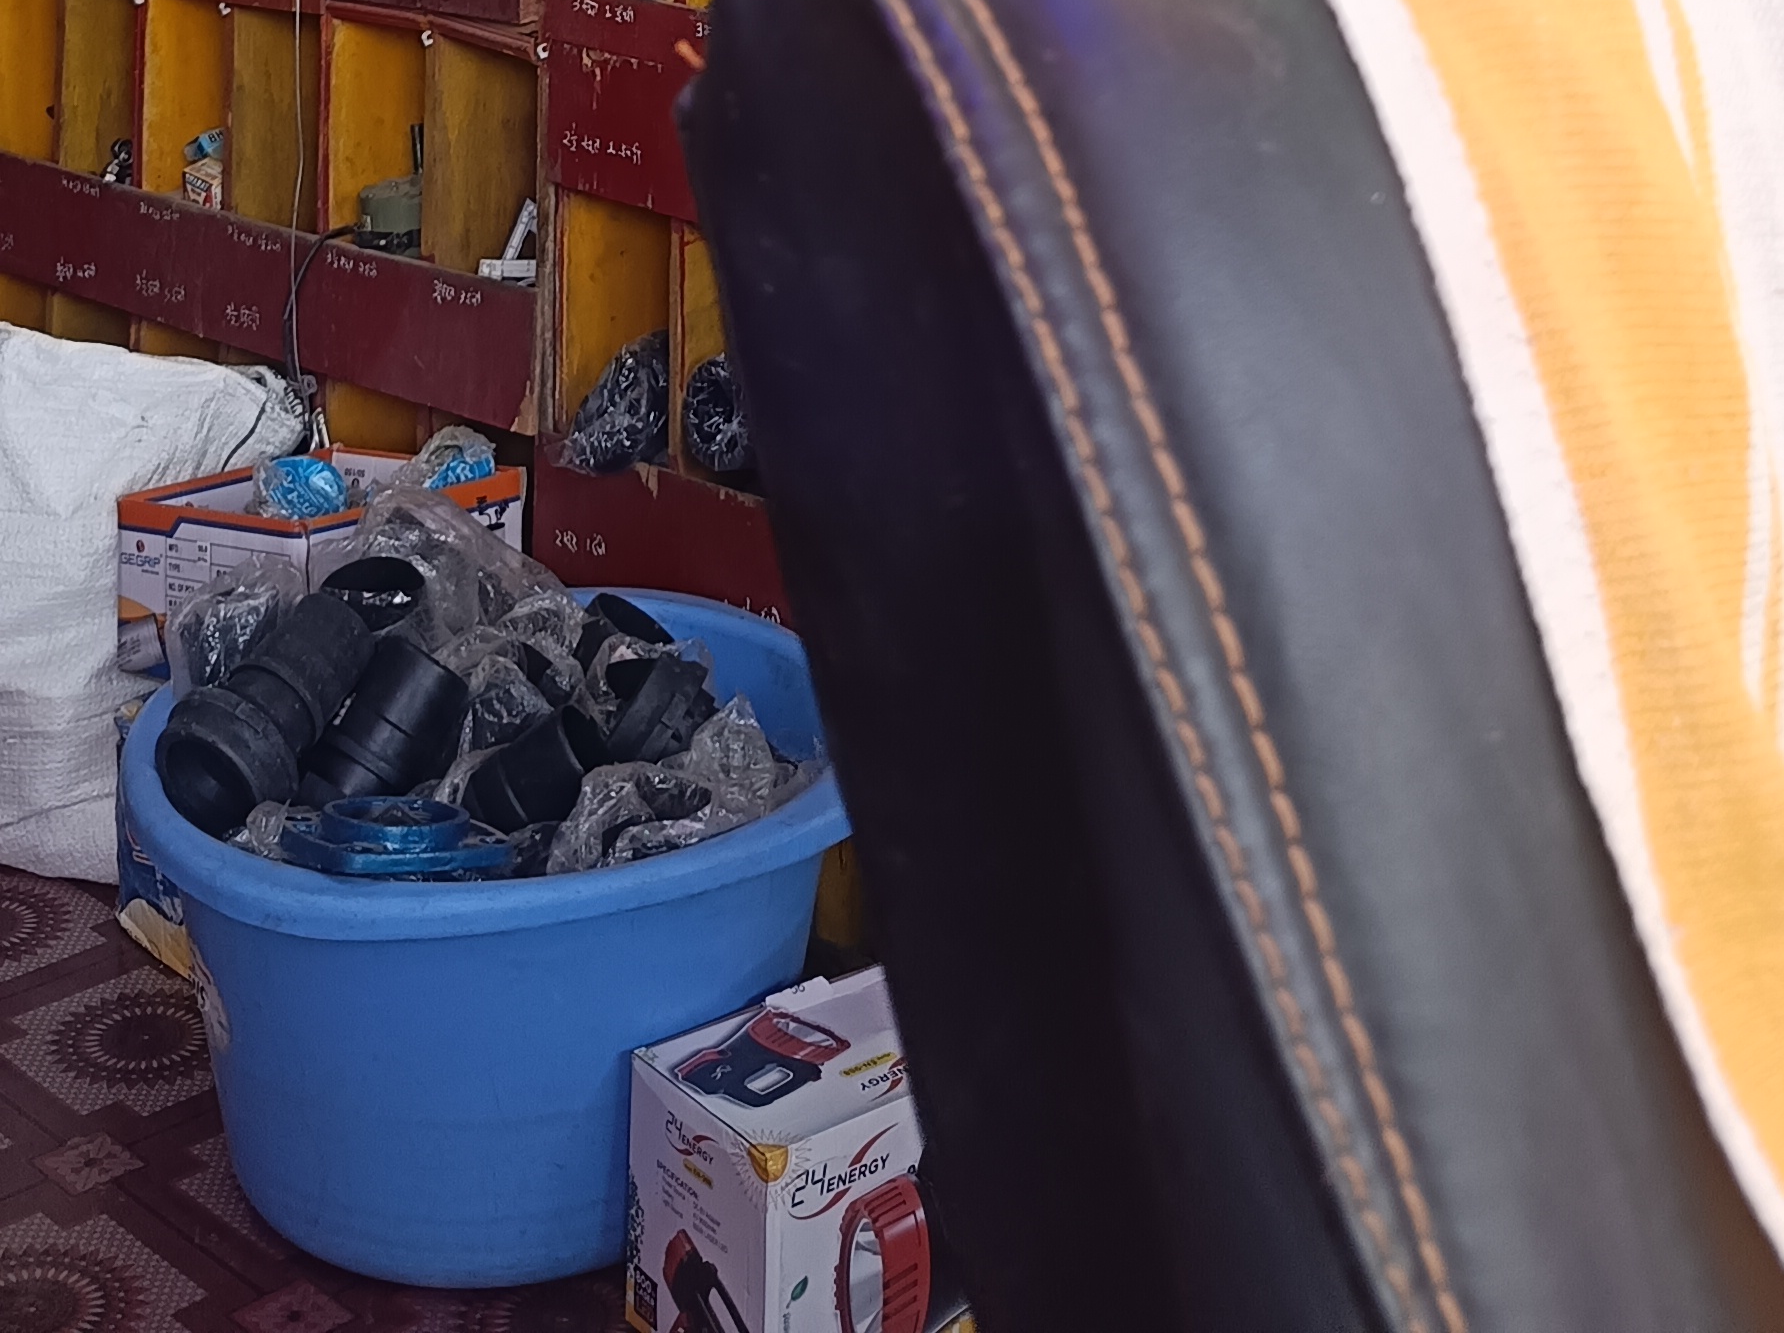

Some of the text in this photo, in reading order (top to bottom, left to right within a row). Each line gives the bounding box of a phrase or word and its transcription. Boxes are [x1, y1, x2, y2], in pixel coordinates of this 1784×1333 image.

[682, 1134, 714, 1166] ENERGY
[790, 1153, 891, 1209] 24 ENERGY
